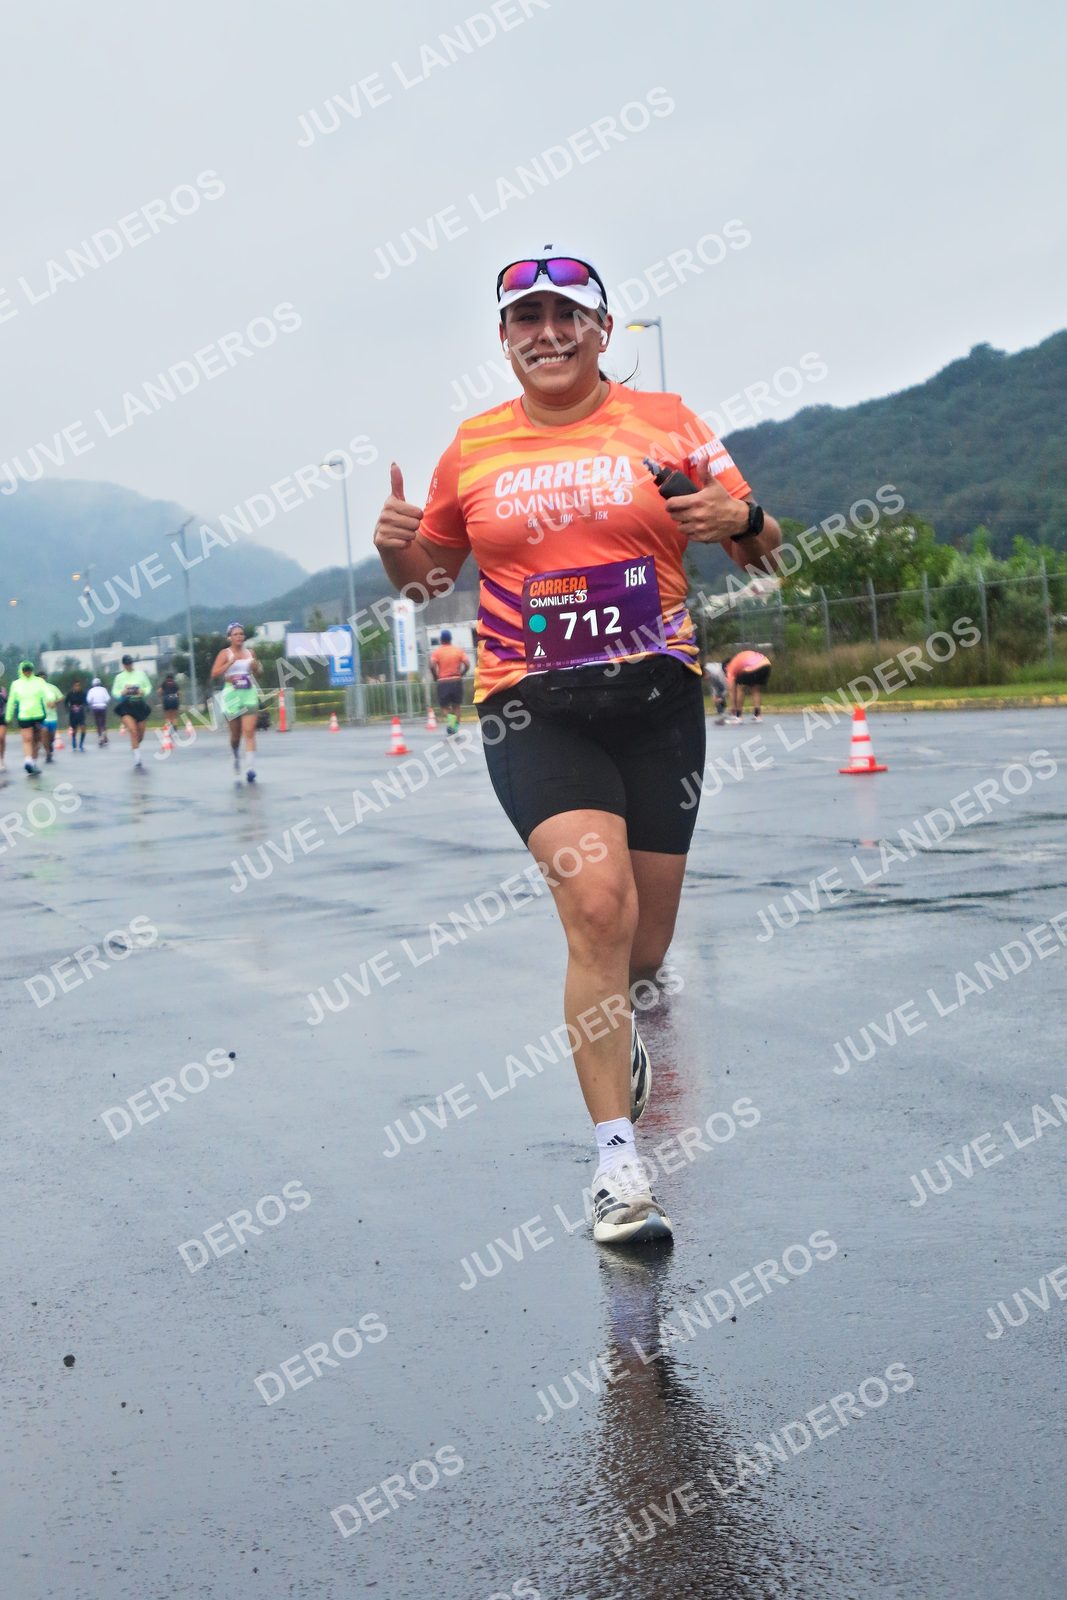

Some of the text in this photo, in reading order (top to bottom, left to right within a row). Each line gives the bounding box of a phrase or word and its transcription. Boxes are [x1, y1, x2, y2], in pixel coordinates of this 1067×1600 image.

[494, 455, 633, 498] CARRERA
[529, 576, 587, 597] CARRERA
[624, 566, 646, 588] 15K
[559, 606, 622, 640] 712
